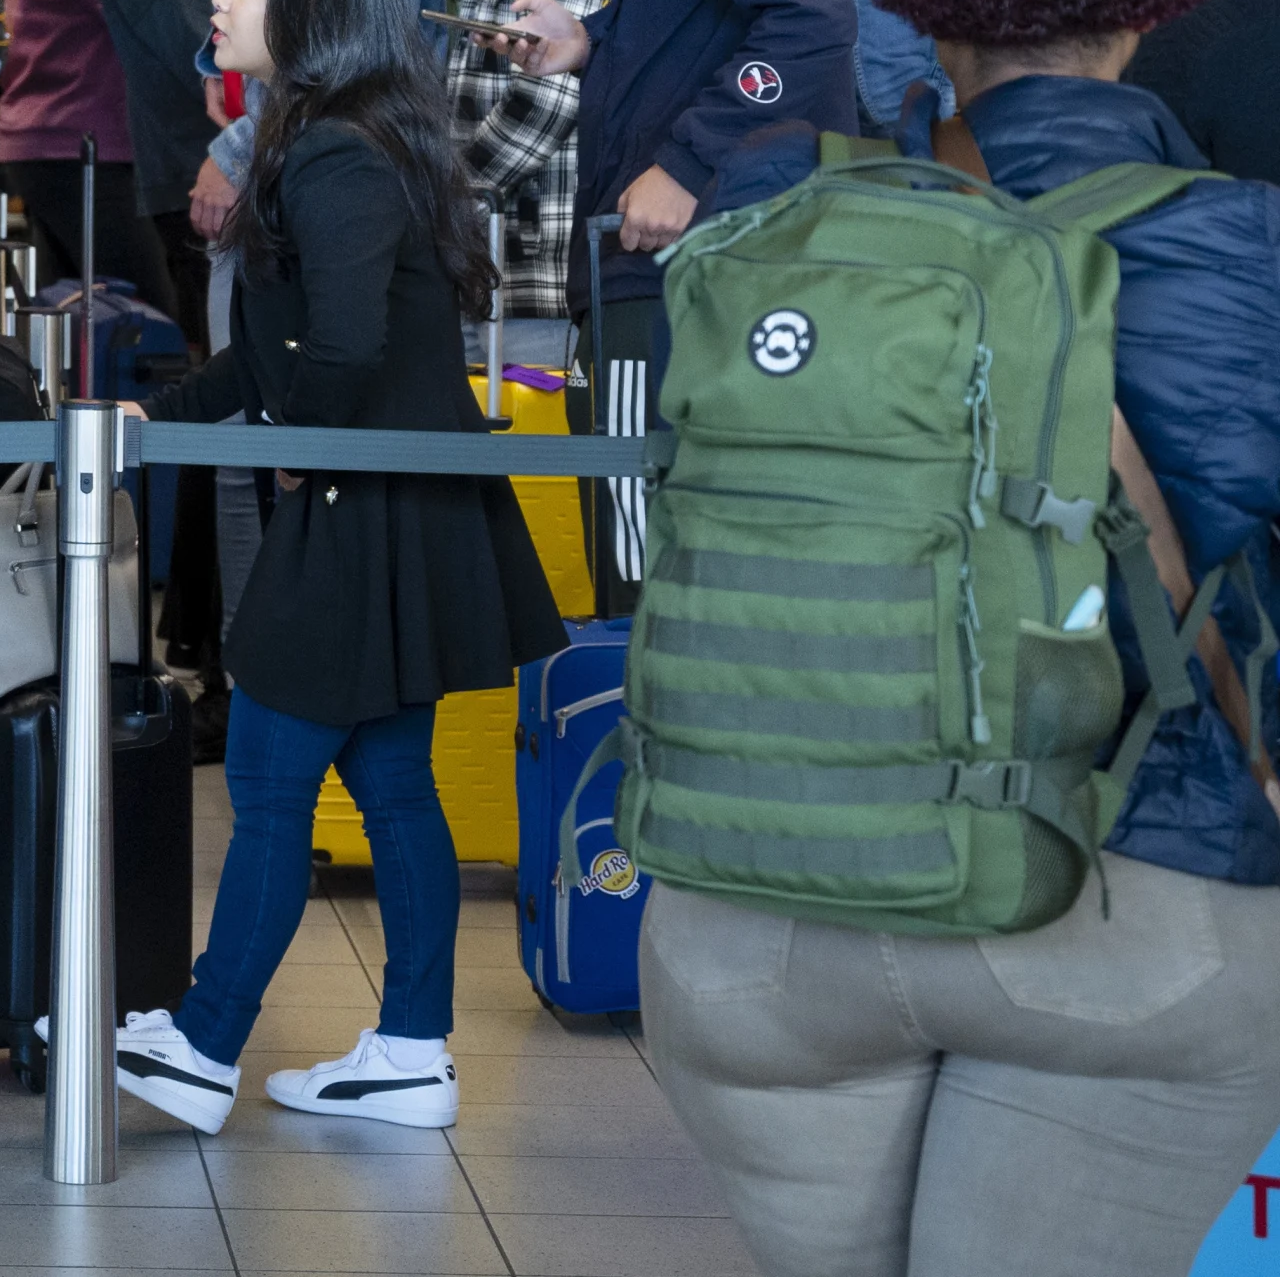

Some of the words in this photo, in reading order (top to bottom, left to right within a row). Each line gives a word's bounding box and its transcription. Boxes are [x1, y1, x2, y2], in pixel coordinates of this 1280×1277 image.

[579, 862, 612, 894] Hard
[609, 855, 629, 871] Ro
[148, 1048, 167, 1060] PUMA
